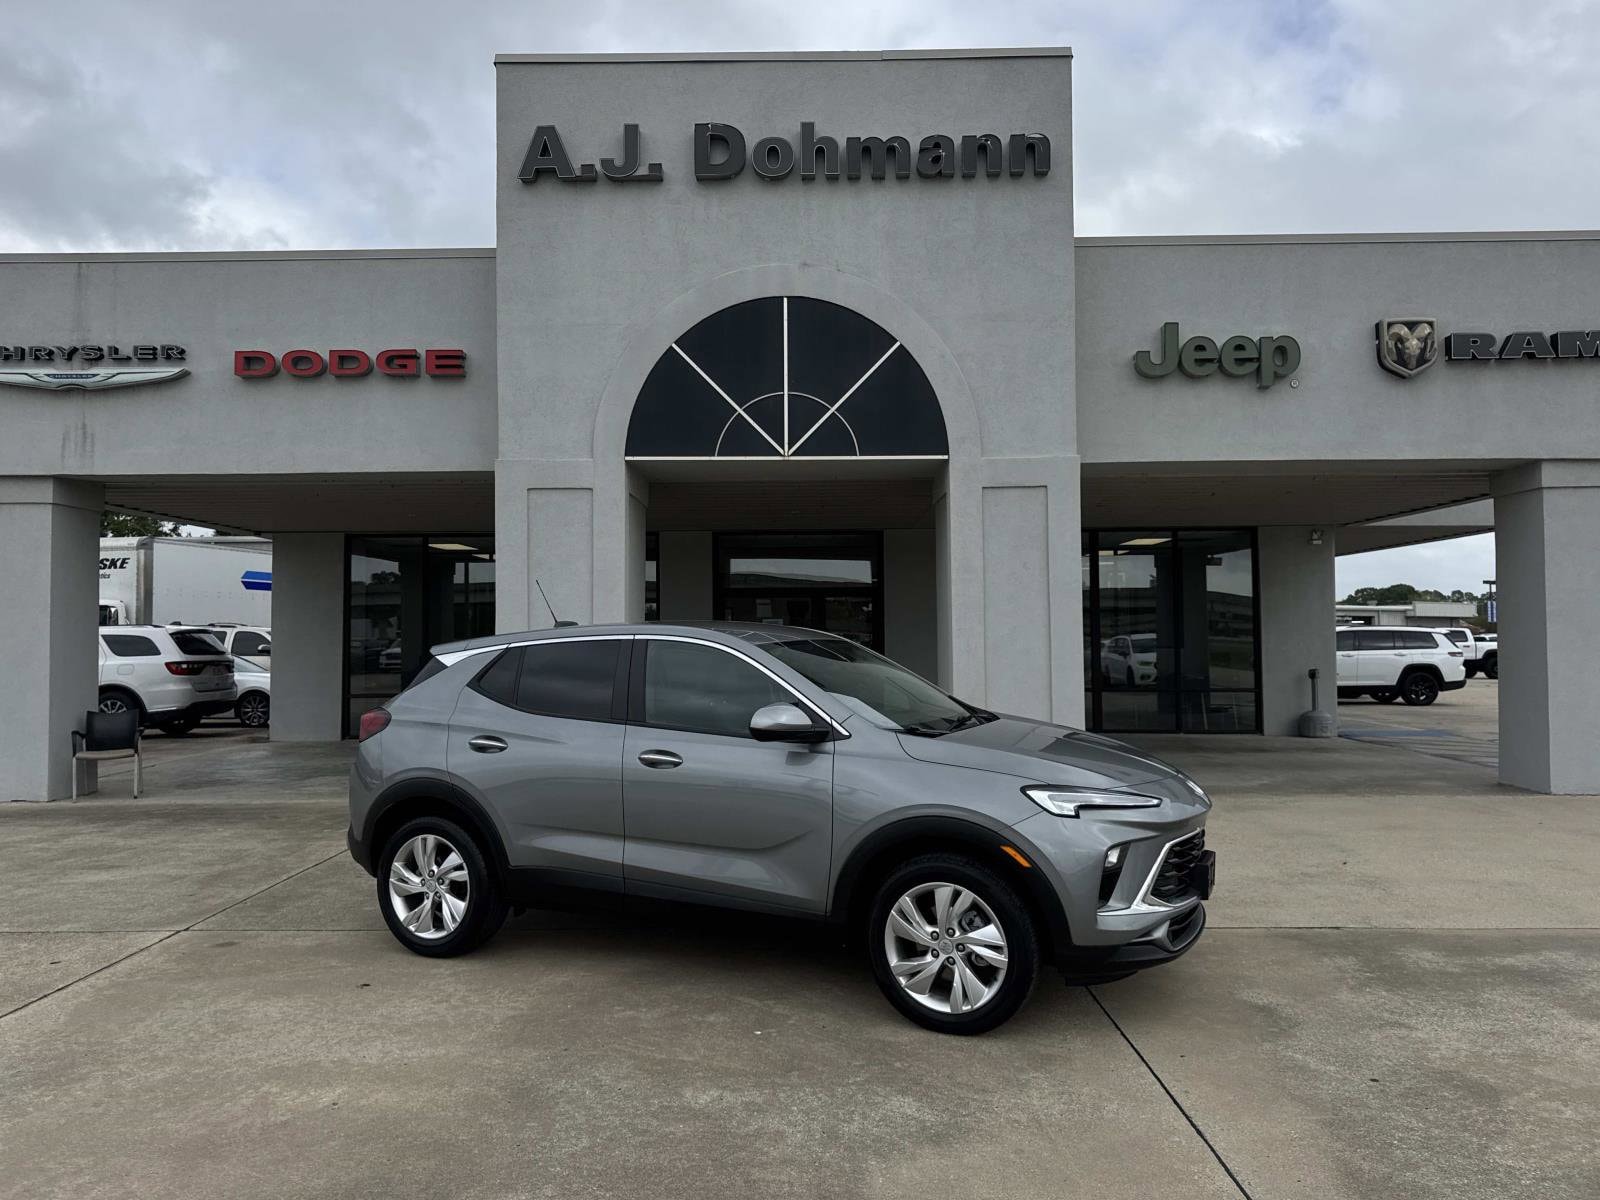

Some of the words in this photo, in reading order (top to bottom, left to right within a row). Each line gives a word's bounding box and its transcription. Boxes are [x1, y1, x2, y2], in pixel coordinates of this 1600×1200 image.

[517, 123, 663, 183] A.J.
[694, 121, 1051, 181] Dohmann
[0, 344, 187, 361] HRYSLER
[1134, 322, 1300, 389] Jeep
[1445, 330, 1600, 361] RAM
[234, 349, 466, 379] DODGE
